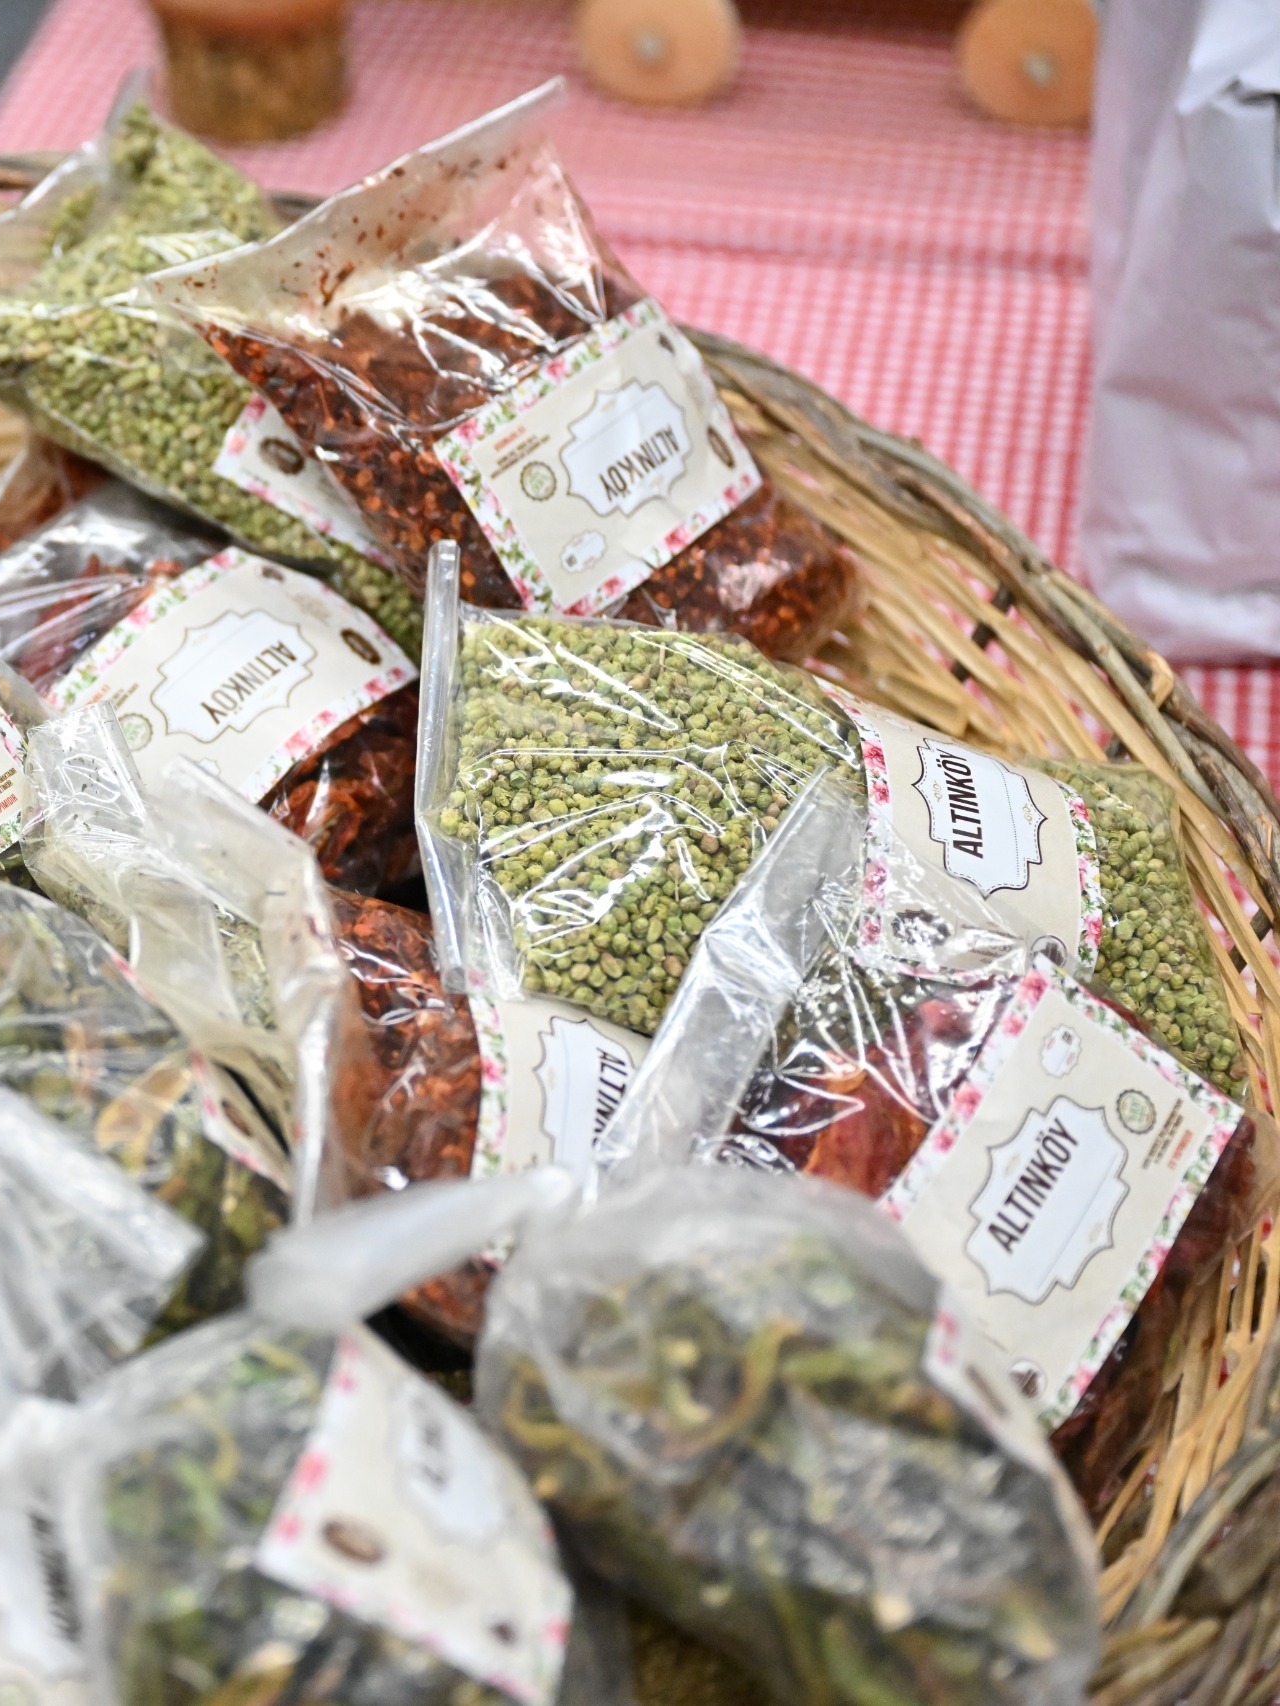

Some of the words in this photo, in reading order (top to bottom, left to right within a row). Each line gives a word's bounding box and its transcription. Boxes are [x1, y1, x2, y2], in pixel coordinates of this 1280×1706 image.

[598, 424, 679, 502] ALTINKÖY
[200, 641, 297, 724] ALTINKÖY
[935, 747, 984, 859] ALTINKÖY
[987, 1116, 1080, 1255] ALTINKÖY
